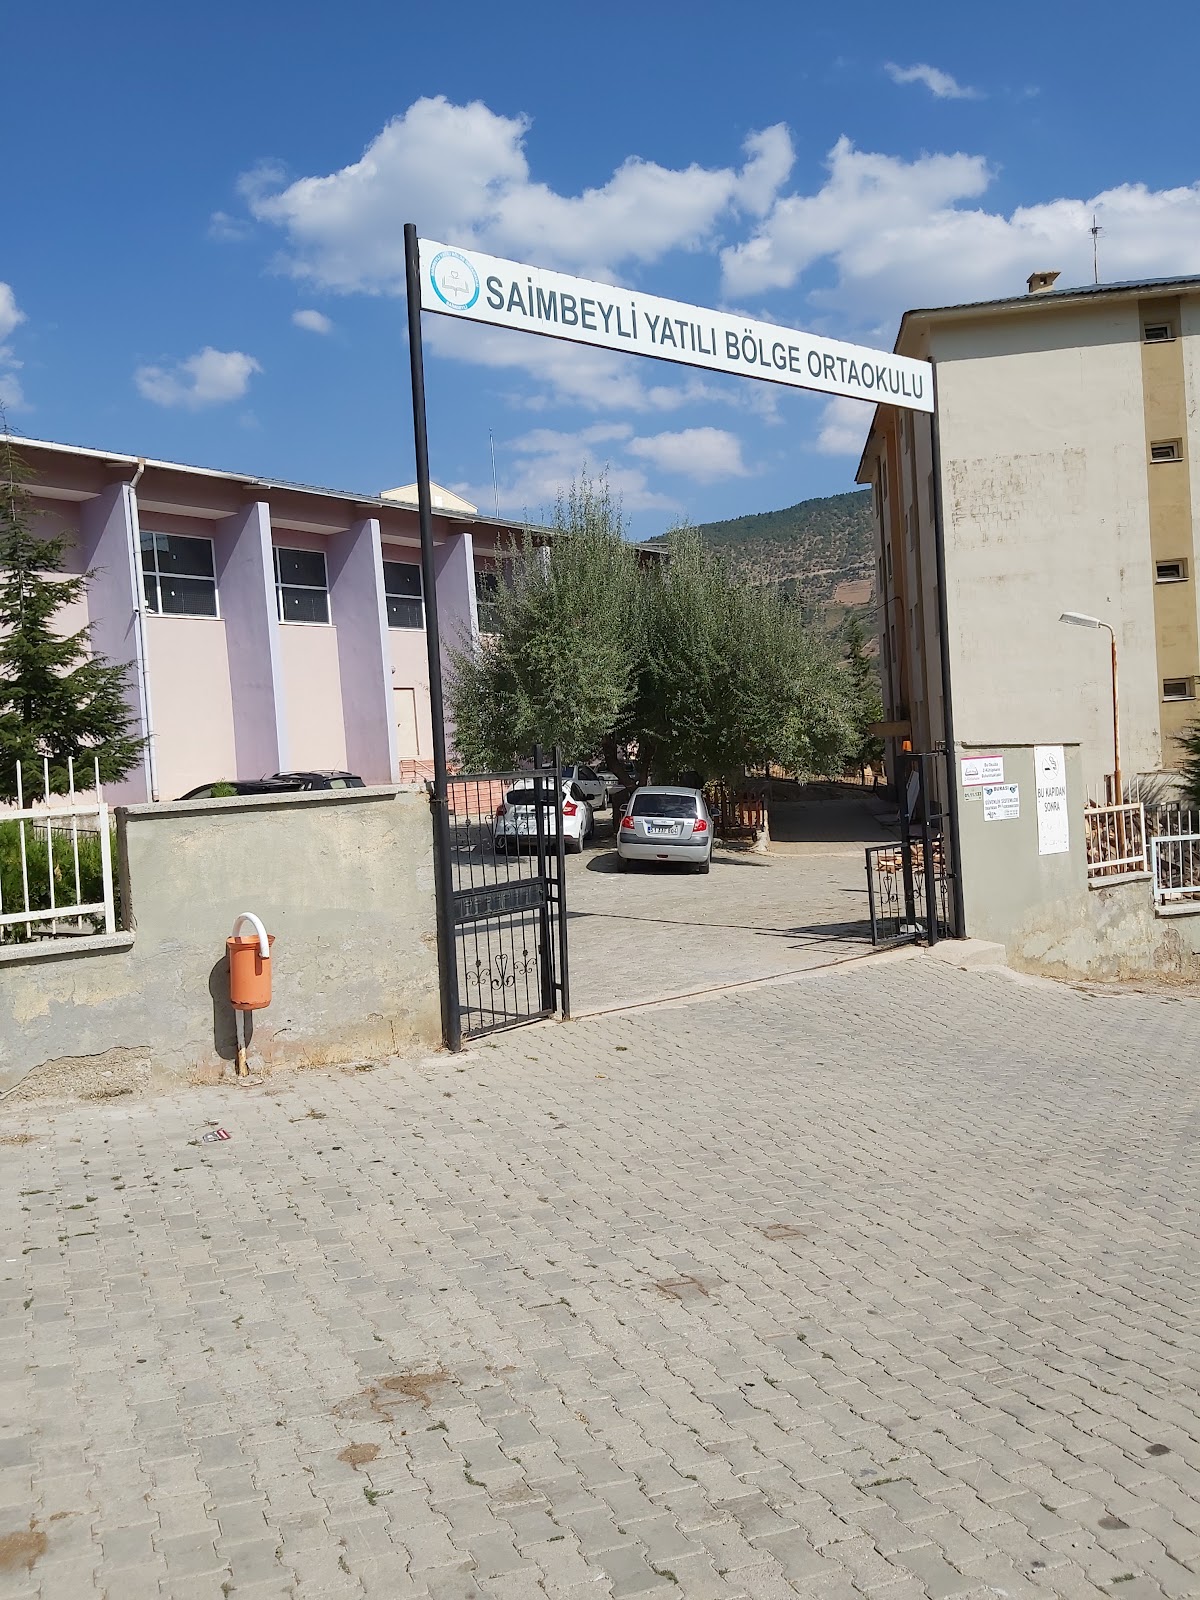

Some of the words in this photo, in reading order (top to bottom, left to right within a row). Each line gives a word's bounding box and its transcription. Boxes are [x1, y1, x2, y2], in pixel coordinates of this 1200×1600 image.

[486, 276, 638, 340] SAİMBEYLİ
[644, 311, 717, 356] YATILI
[725, 328, 802, 374] BÖLGE
[807, 350, 923, 399] ORTAOKULU
[1037, 788, 1045, 798] BU
[1045, 786, 1066, 798] KAPIDAN
[1044, 801, 1061, 812] SONRA
